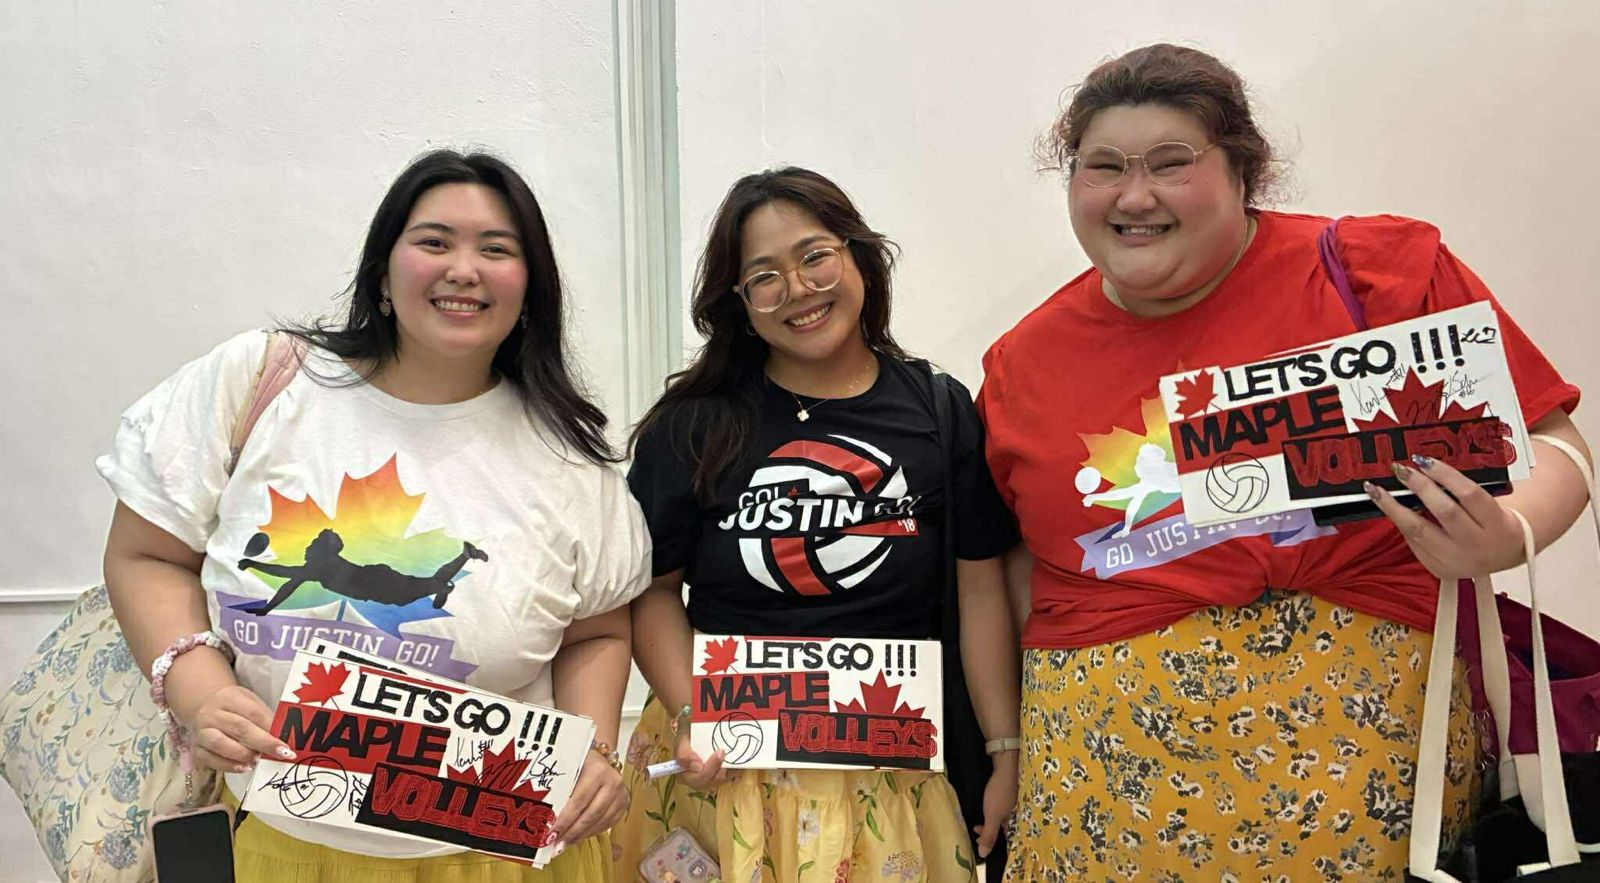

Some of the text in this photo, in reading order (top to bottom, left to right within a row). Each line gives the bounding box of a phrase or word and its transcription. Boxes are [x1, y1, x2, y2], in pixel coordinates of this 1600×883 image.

[1223, 353, 1326, 401] LET'S
[1330, 339, 1397, 380] GO
[1178, 384, 1344, 461] MAPLE
[1284, 420, 1517, 487] VOLLEYS
[718, 497, 865, 531] JUSTIN
[738, 486, 779, 509] GO!
[1106, 543, 1134, 569] GO
[233, 619, 259, 645] GO
[395, 640, 440, 667] GO!
[745, 641, 823, 669] LET'S
[827, 642, 874, 671] GO
[350, 672, 452, 724] LET'S
[453, 698, 511, 736] GO
[699, 673, 830, 713] MAPLE
[279, 706, 451, 769] MAPLE
[780, 712, 938, 758] VOLLEYS
[369, 767, 557, 849] VOLLEYS
